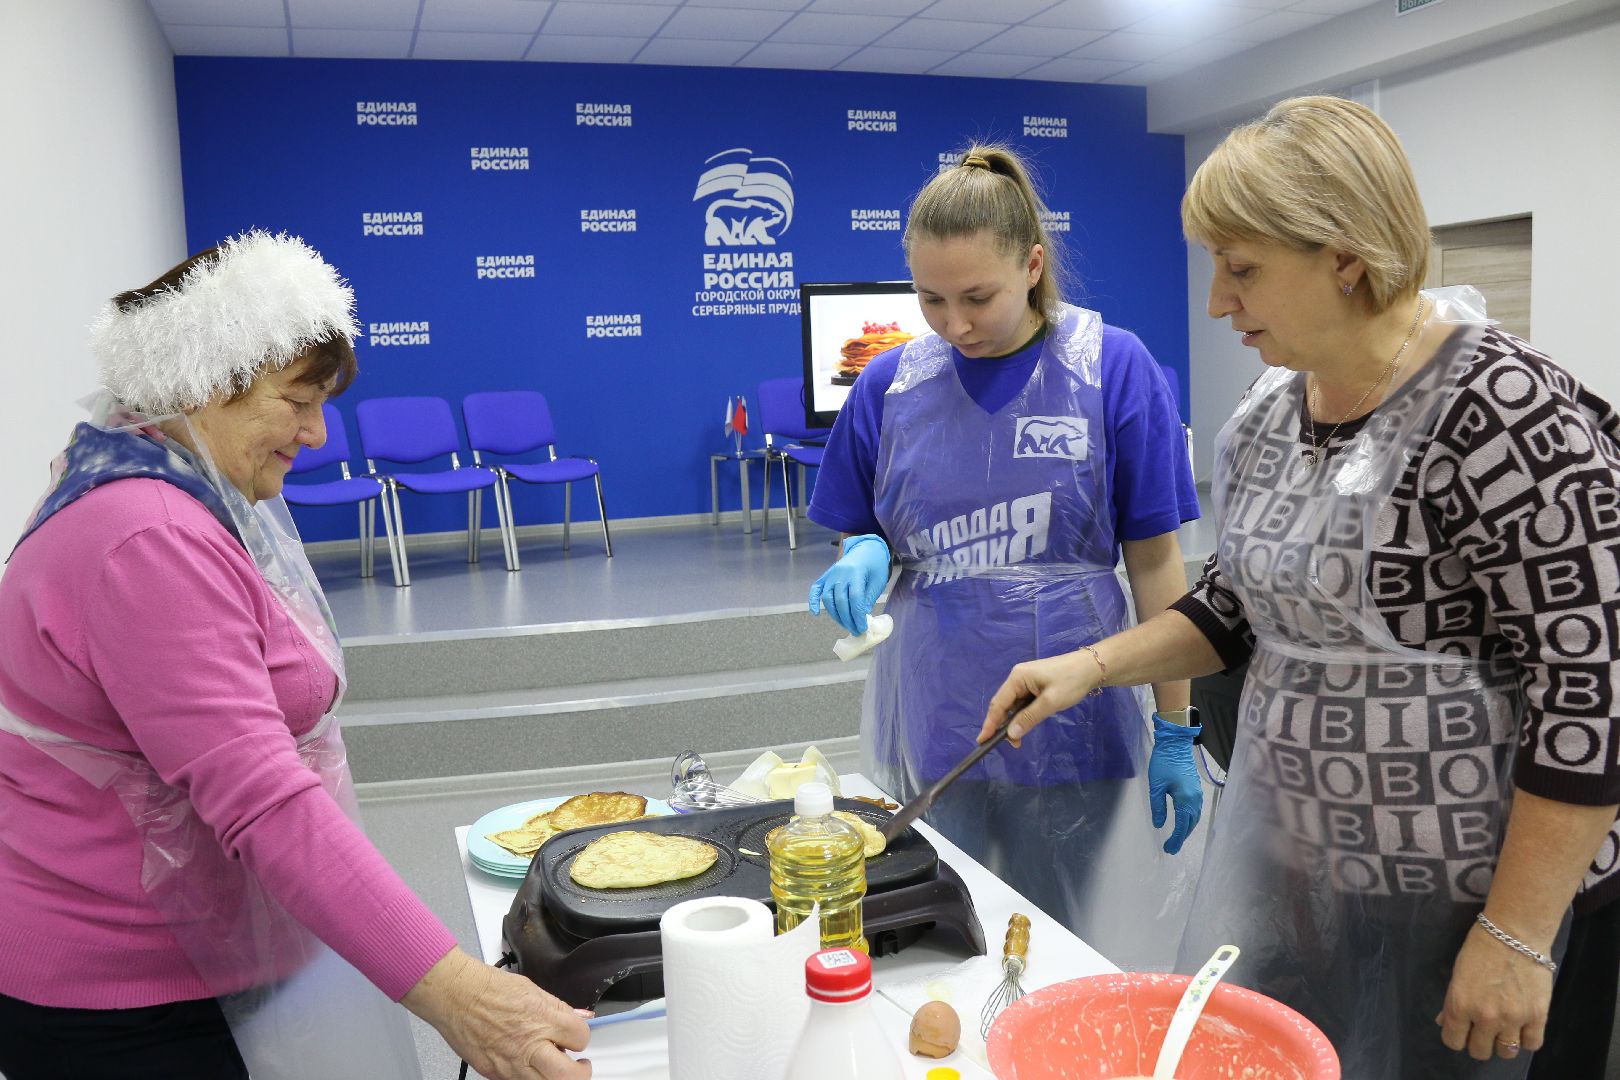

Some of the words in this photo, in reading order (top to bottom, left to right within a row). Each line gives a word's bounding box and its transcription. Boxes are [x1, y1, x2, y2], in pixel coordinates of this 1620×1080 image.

[356, 102, 417, 114] ЕДИНАЯ
[575, 103, 632, 114] ЕДИНАЯ
[357, 114, 418, 126] РОССИЯ
[576, 115, 632, 127] РОССИЯ
[847, 110, 897, 121] ЕДИНАЯ
[1023, 116, 1067, 127] ЕДИНАЯ
[847, 121, 897, 132] РОССИЯ
[1023, 127, 1068, 138] РОССИЯ
[470, 147, 529, 158] ЕДИНАЯ
[471, 158, 530, 171] РОССИЯ
[362, 212, 423, 223] ЕДИНАЯ
[580, 209, 636, 221] ЕДИНАЯ
[851, 209, 901, 220] ЕДИНАЯ
[1039, 211, 1070, 221] ИНАЯ
[363, 223, 424, 236] РОССИЯ
[581, 221, 637, 233] РОССИЯ
[852, 220, 901, 231] РОССИЯ
[476, 254, 535, 267] ЕДИНАЯ
[703, 252, 794, 271] ЕДИНАЯ
[477, 266, 535, 280] РОССИЯ
[704, 271, 794, 290] РОССИЯ
[695, 289, 765, 304] ГОРОДСКОЙ
[692, 303, 766, 316] СЕРЕБРЯНЫЕ
[585, 313, 642, 326] ЕДИНАЯ
[369, 321, 430, 334] ЕДИНАЯ
[586, 325, 642, 339] РОССИЯ
[370, 333, 431, 347] РОССИЯ
